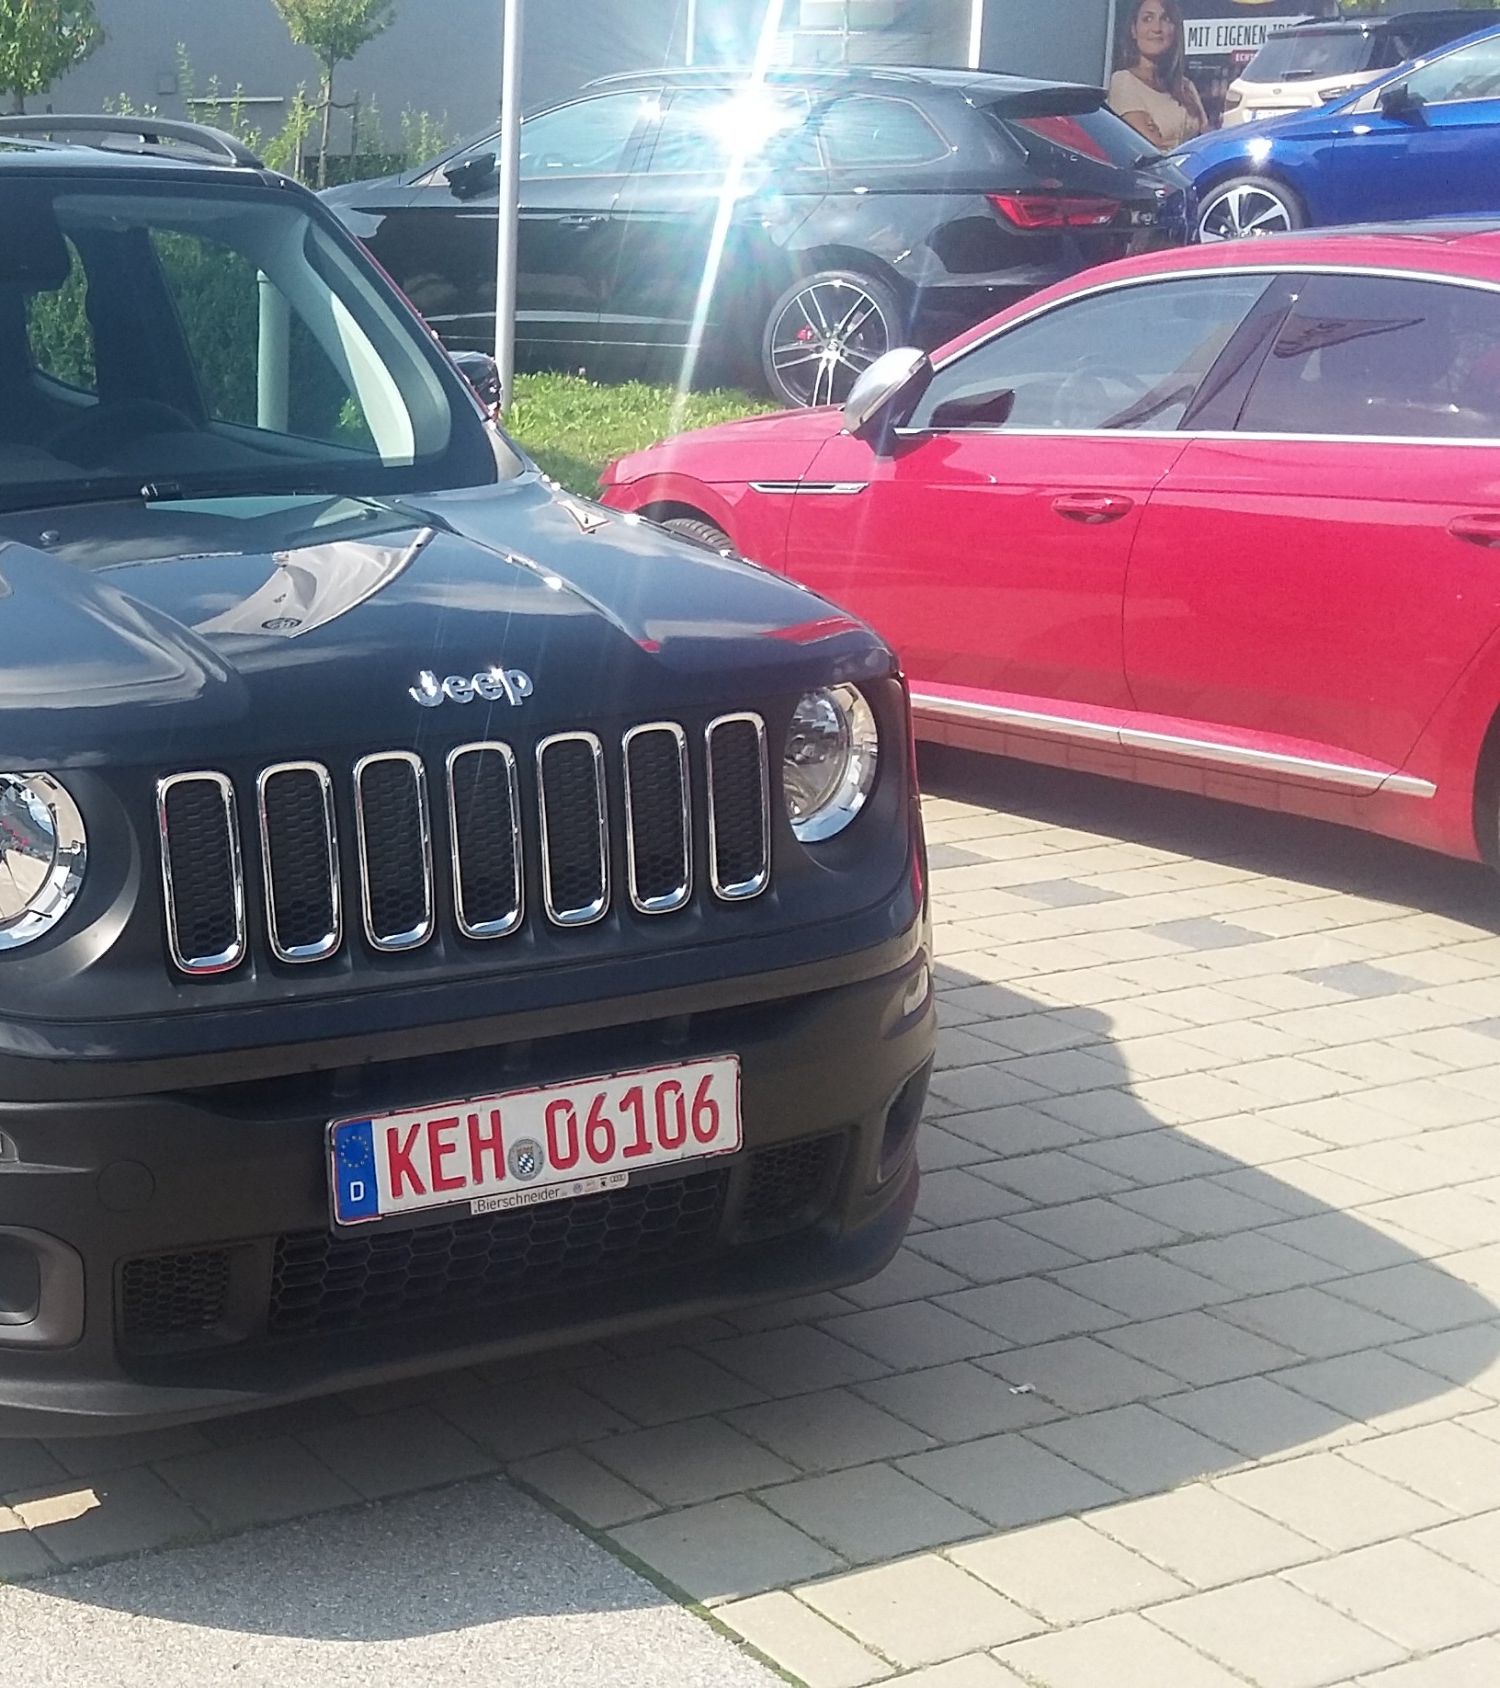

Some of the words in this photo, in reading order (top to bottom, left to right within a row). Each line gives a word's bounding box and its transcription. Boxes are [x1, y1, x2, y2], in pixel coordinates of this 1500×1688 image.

[1188, 26, 1211, 48] MIT
[1216, 25, 1267, 47] EIGENEN
[408, 667, 534, 708] Jeep
[350, 1181, 364, 1202] D
[385, 1109, 506, 1200] KEH
[544, 1074, 720, 1171] 06106
